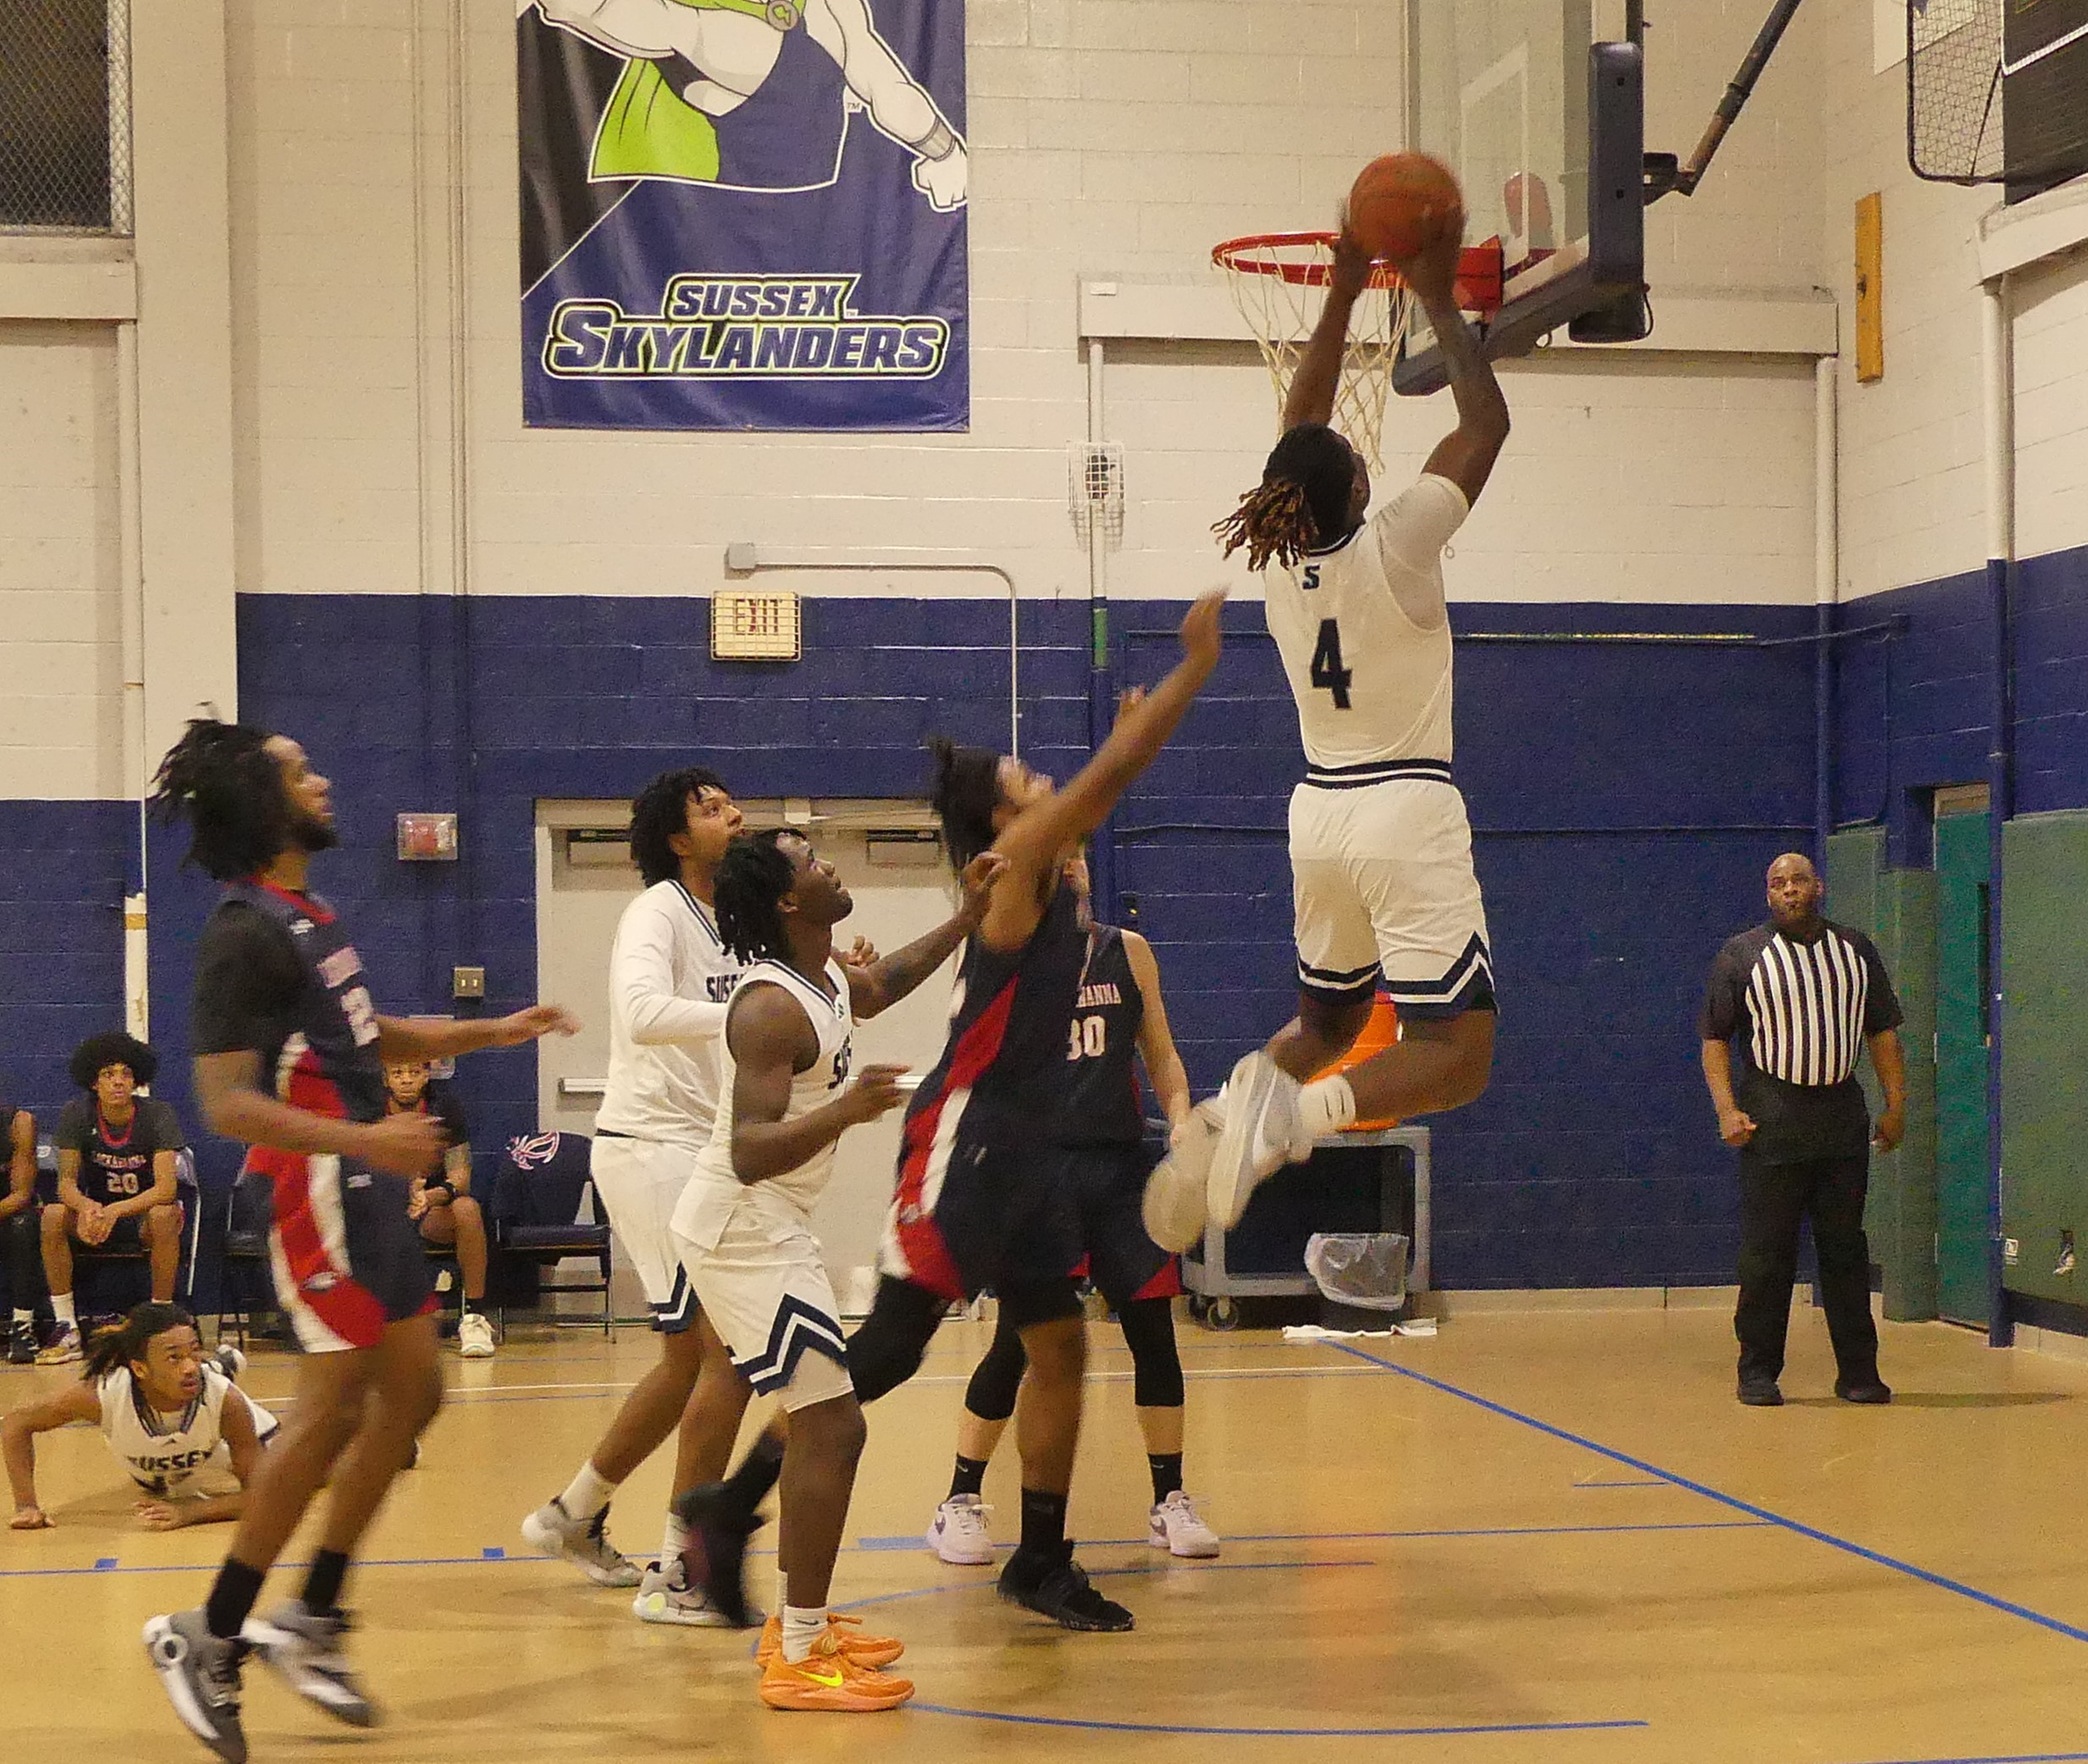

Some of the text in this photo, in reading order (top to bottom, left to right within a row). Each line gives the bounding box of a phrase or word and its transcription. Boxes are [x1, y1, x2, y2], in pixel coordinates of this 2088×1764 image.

[671, 282, 844, 318] SUSSEX
[553, 307, 941, 370] SKYLANDERS
[734, 598, 783, 635] EXIT
[1311, 617, 1353, 709] 4
